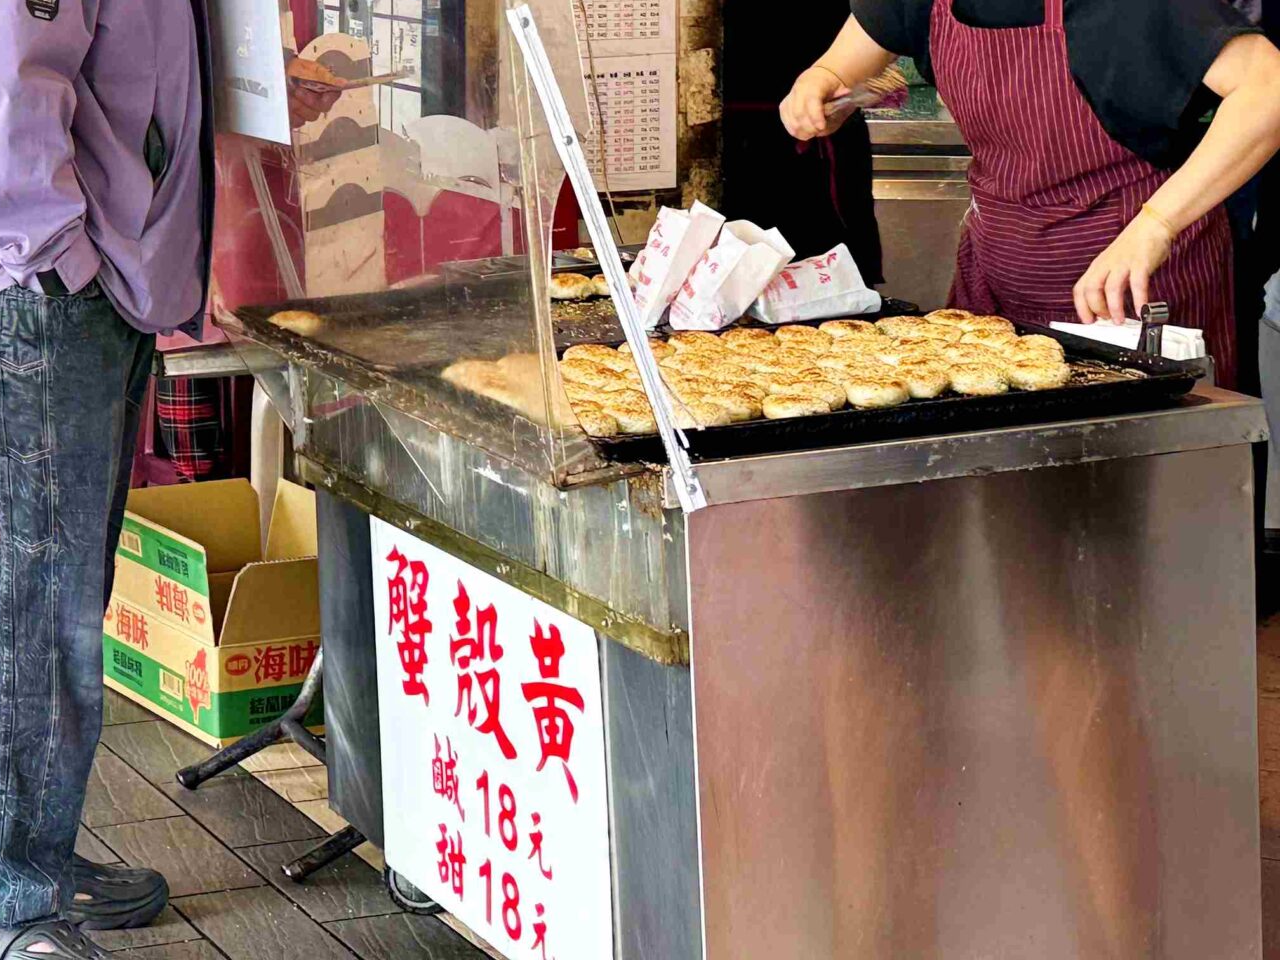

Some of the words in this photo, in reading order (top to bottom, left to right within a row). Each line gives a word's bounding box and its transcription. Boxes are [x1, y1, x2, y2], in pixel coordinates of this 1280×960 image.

[116, 602, 149, 651] 海味
[253, 640, 320, 685] 海味
[386, 543, 586, 804] 蟹殼黃
